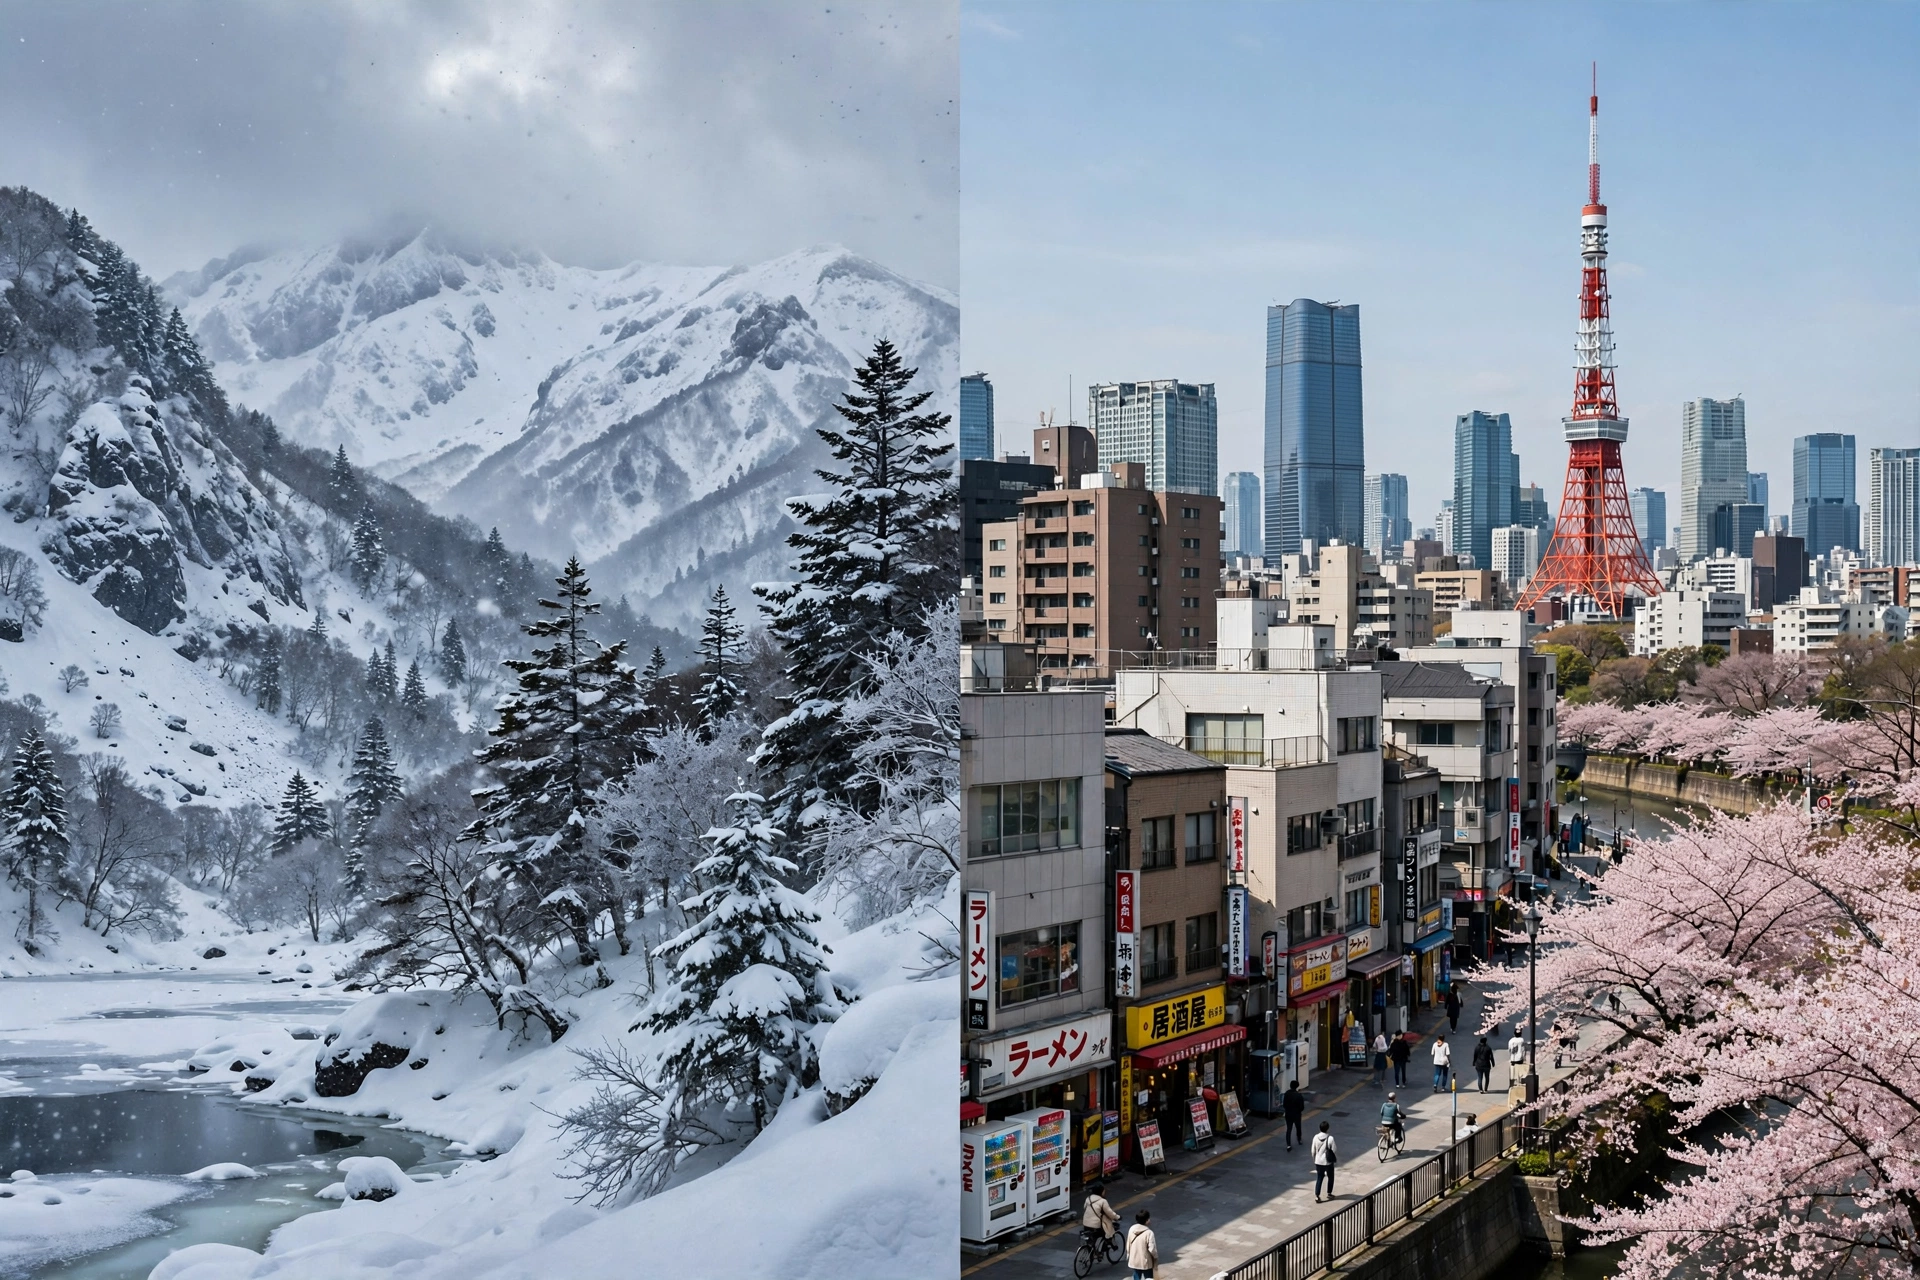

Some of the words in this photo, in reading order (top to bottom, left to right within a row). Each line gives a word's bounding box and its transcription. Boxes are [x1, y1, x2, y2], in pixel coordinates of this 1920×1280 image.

[970, 900, 987, 991] ラーメン
[1151, 995, 1206, 1039] 居酒屋
[1009, 1029, 1088, 1078] ラーメン
